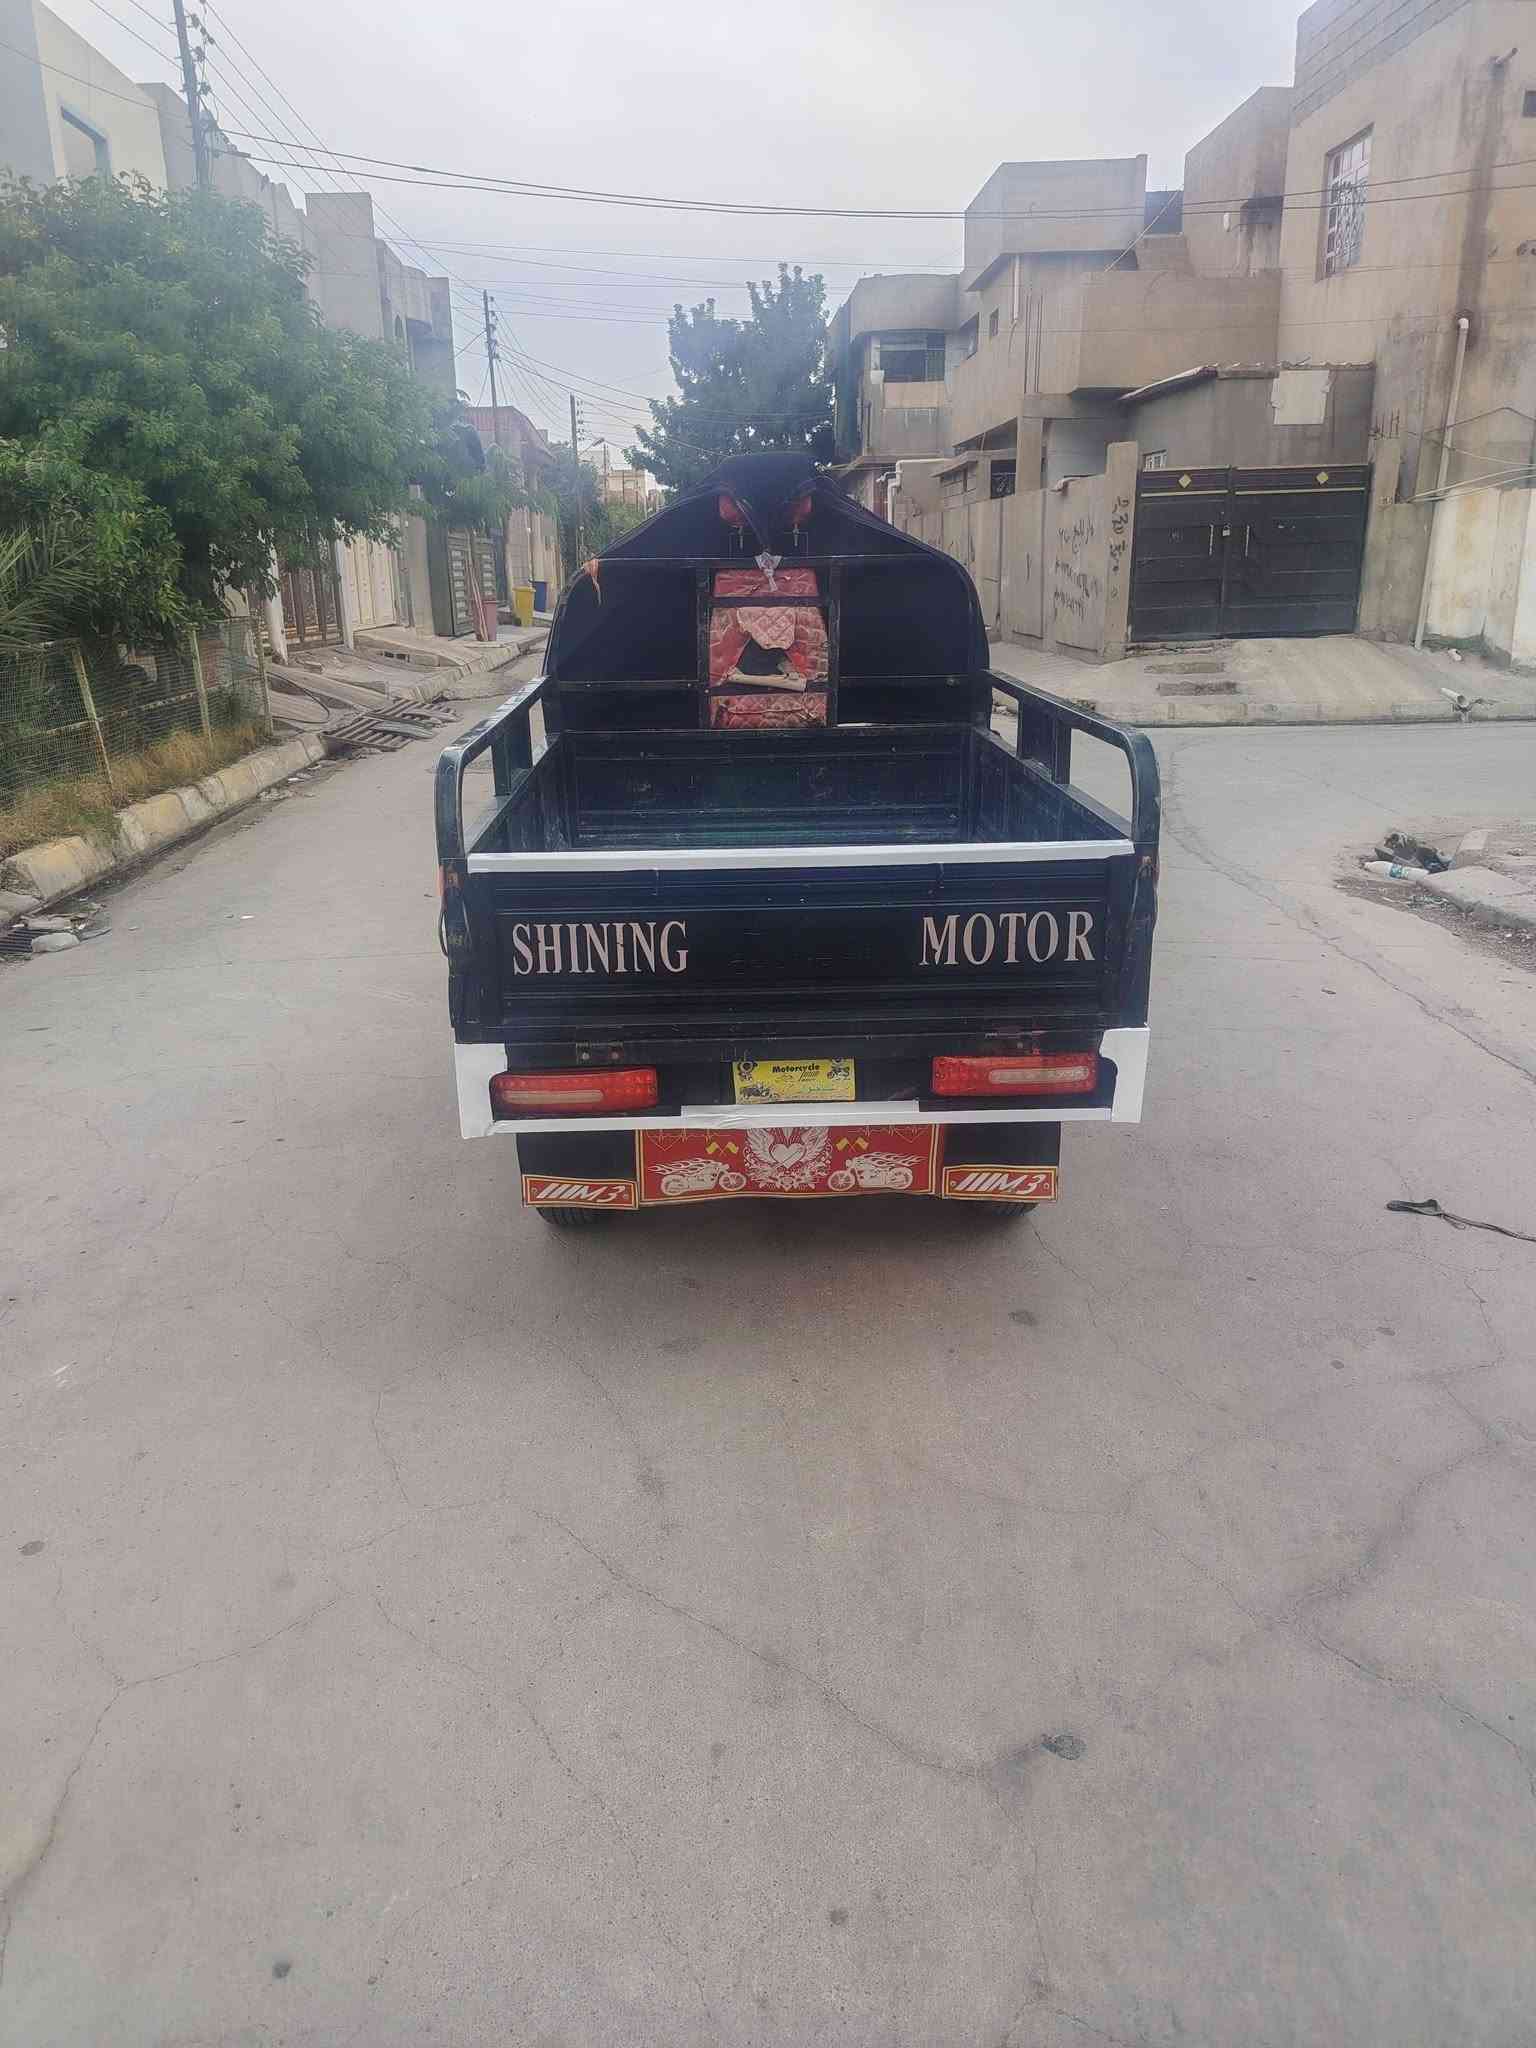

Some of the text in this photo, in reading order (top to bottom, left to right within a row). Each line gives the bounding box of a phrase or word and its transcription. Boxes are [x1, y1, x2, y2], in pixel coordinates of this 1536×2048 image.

[512, 911, 1096, 976] SHINING MOTOR
[772, 1063, 820, 1074] Motorcycle
